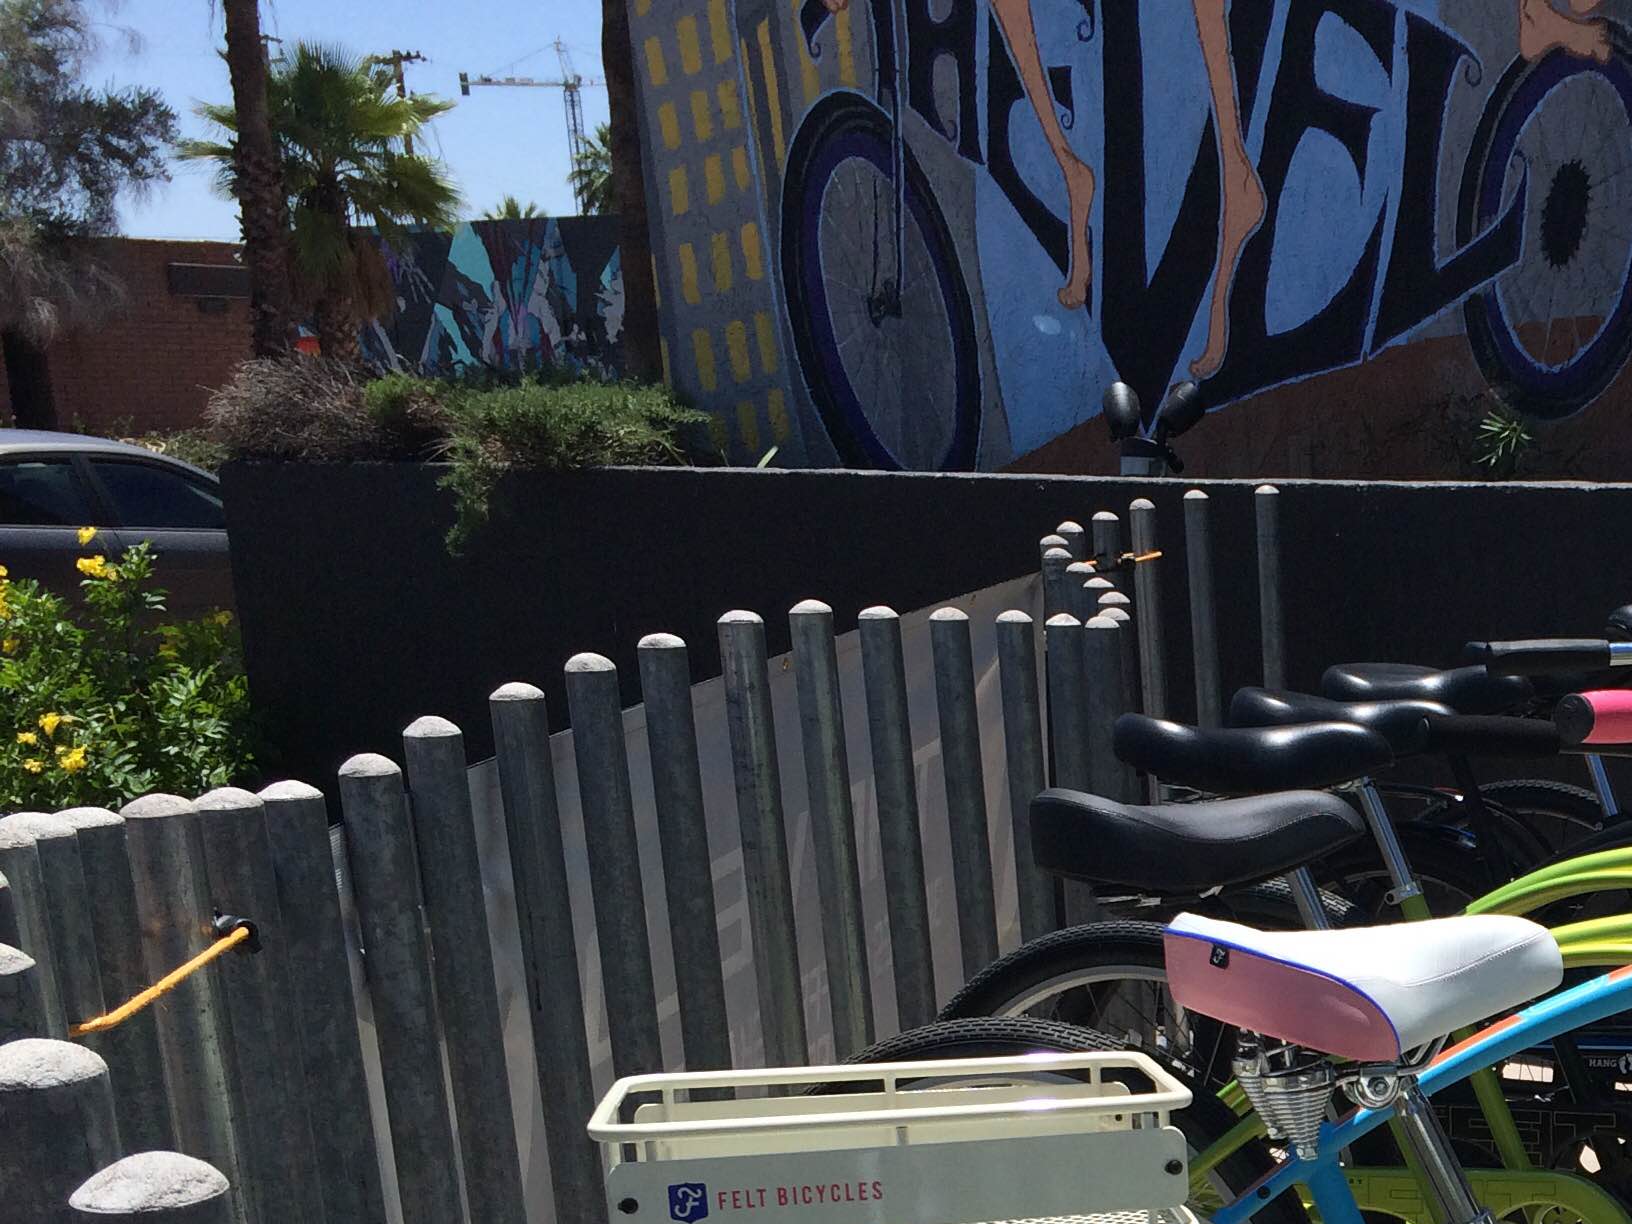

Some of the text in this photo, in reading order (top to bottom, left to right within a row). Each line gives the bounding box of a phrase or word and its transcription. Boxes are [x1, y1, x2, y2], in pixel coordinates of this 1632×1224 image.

[1588, 1058, 1617, 1068] HANG
[717, 1181, 884, 1210] FELT BICYCLES
